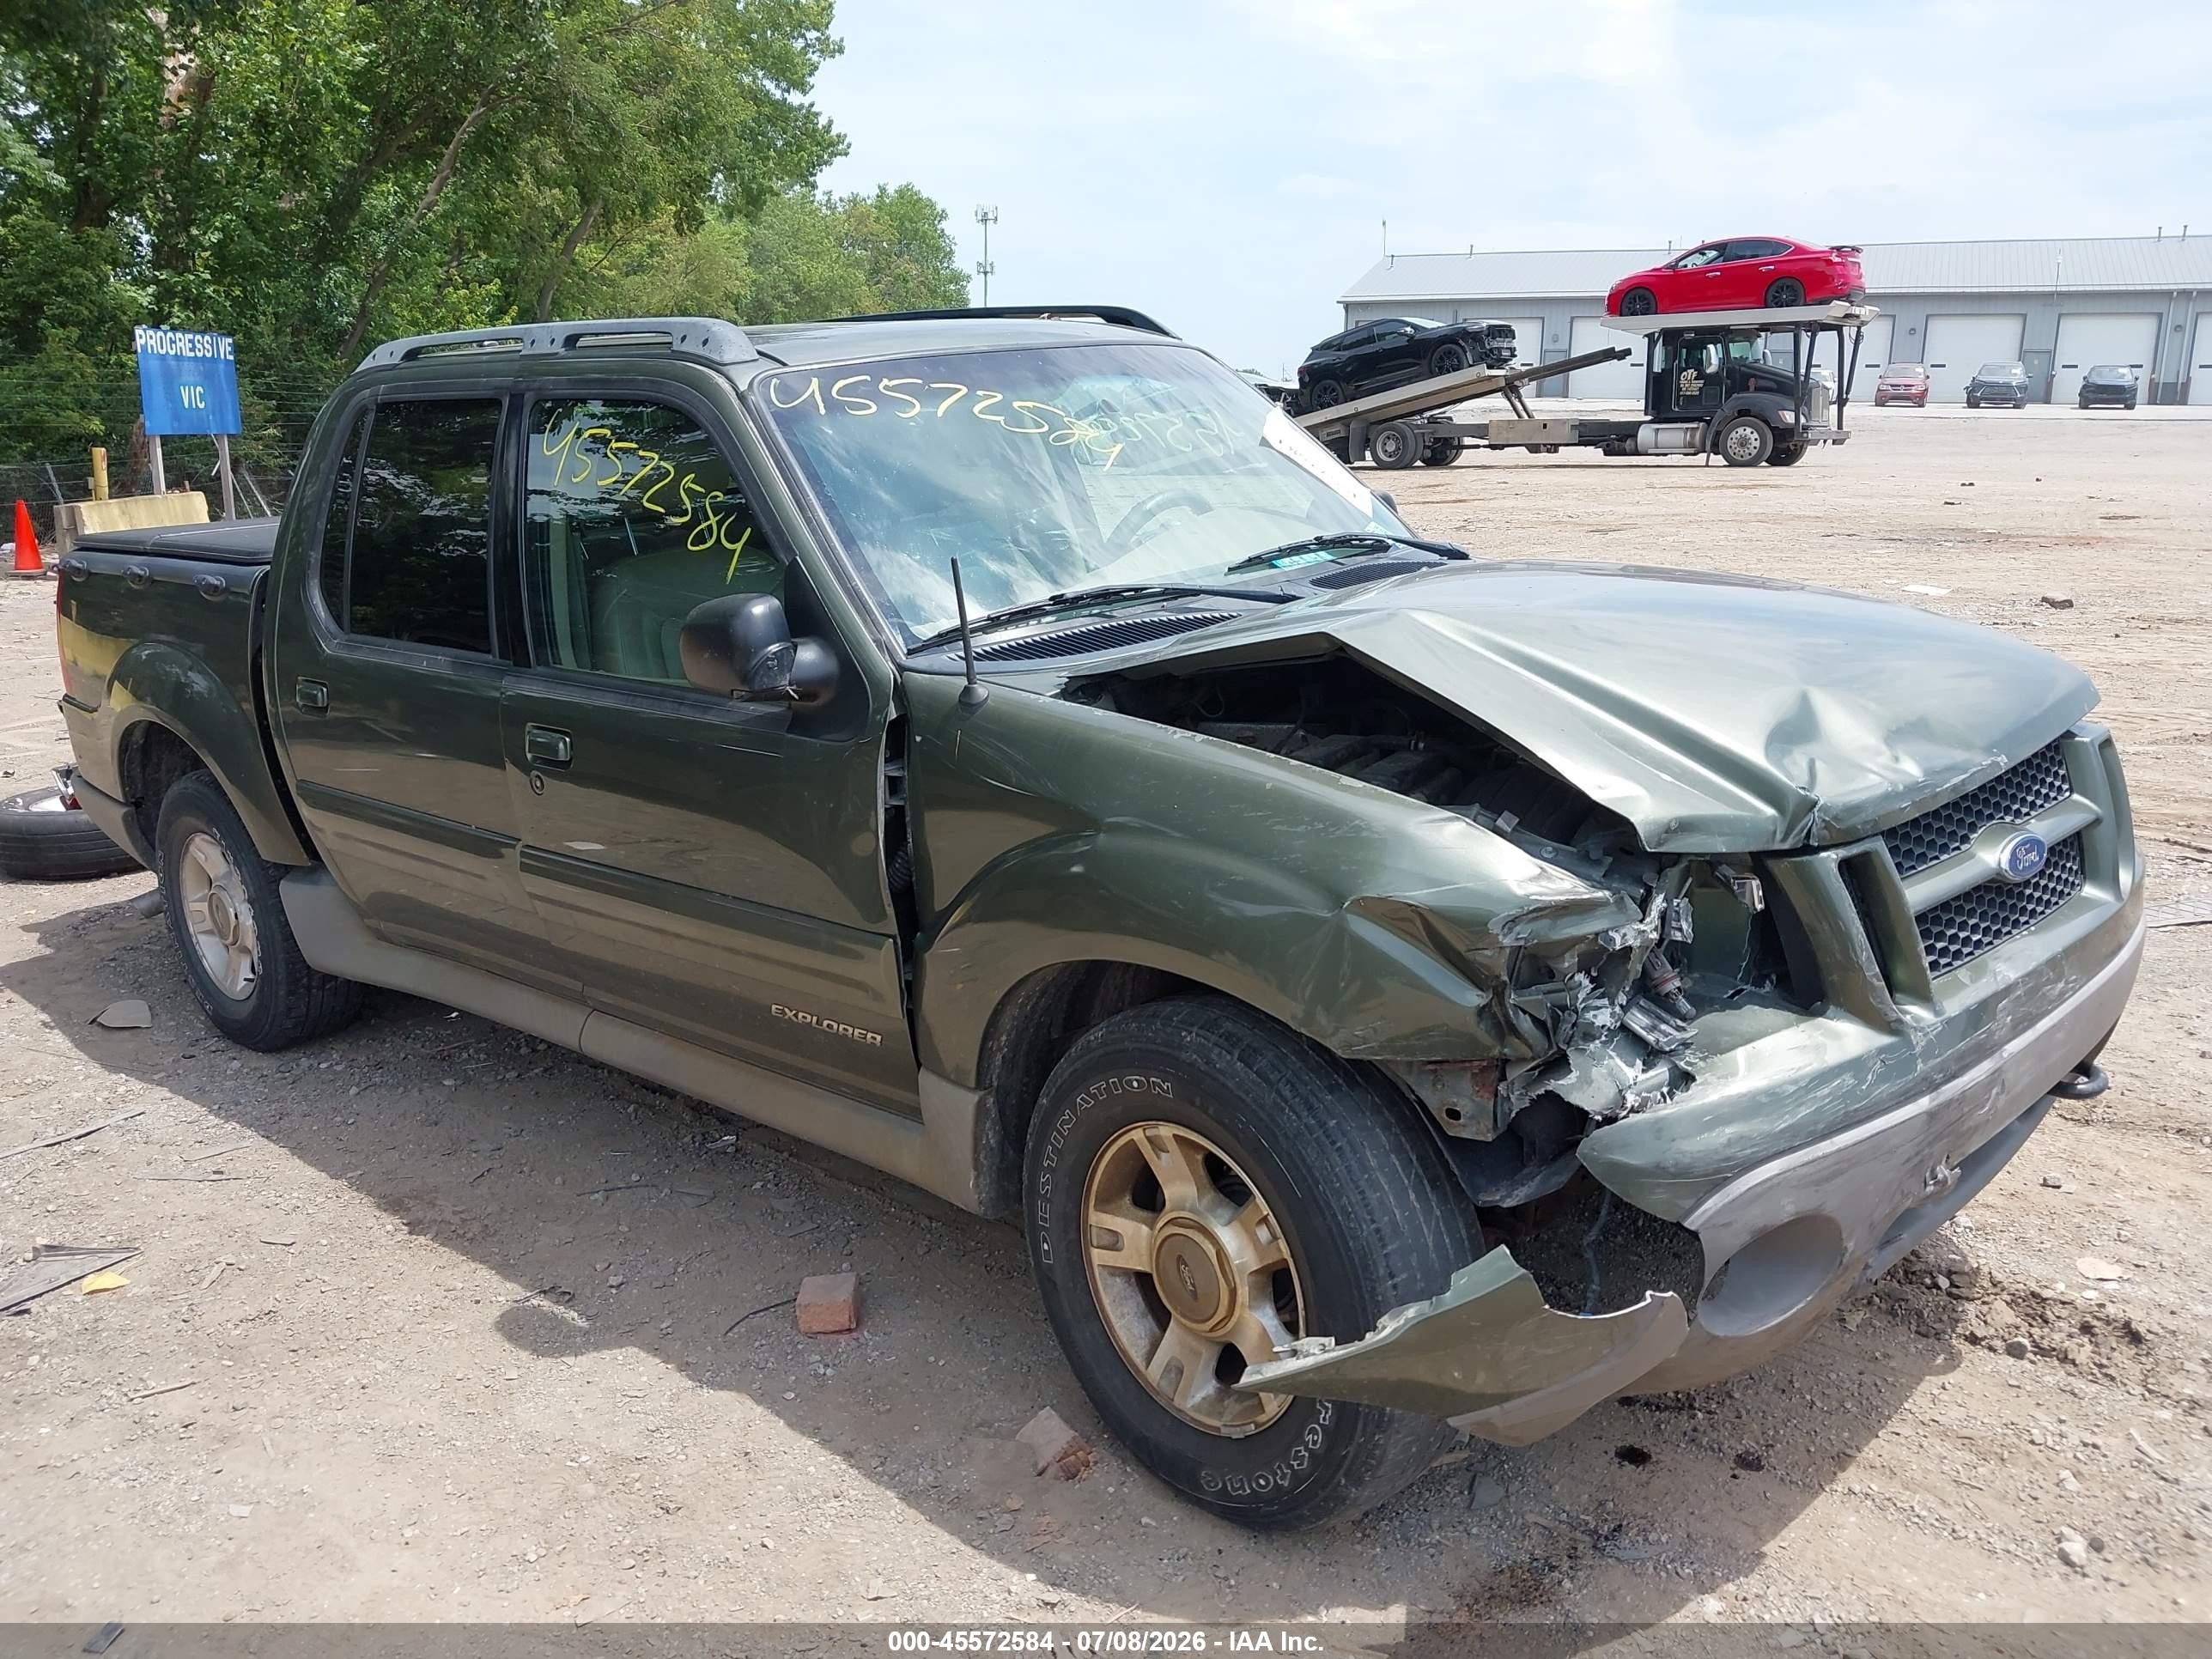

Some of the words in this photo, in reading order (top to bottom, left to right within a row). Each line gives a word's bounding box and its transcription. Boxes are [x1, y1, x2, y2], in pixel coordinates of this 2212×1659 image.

[135, 329, 234, 361] PROGRESSIVE
[1680, 368, 1698, 380] OTF
[180, 386, 205, 409] VIC
[543, 408, 751, 585] 45572584
[2015, 843, 2039, 870] Ford
[770, 1003, 884, 1047] EXPLORER
[1038, 1076, 1174, 1264] DESTINATION
